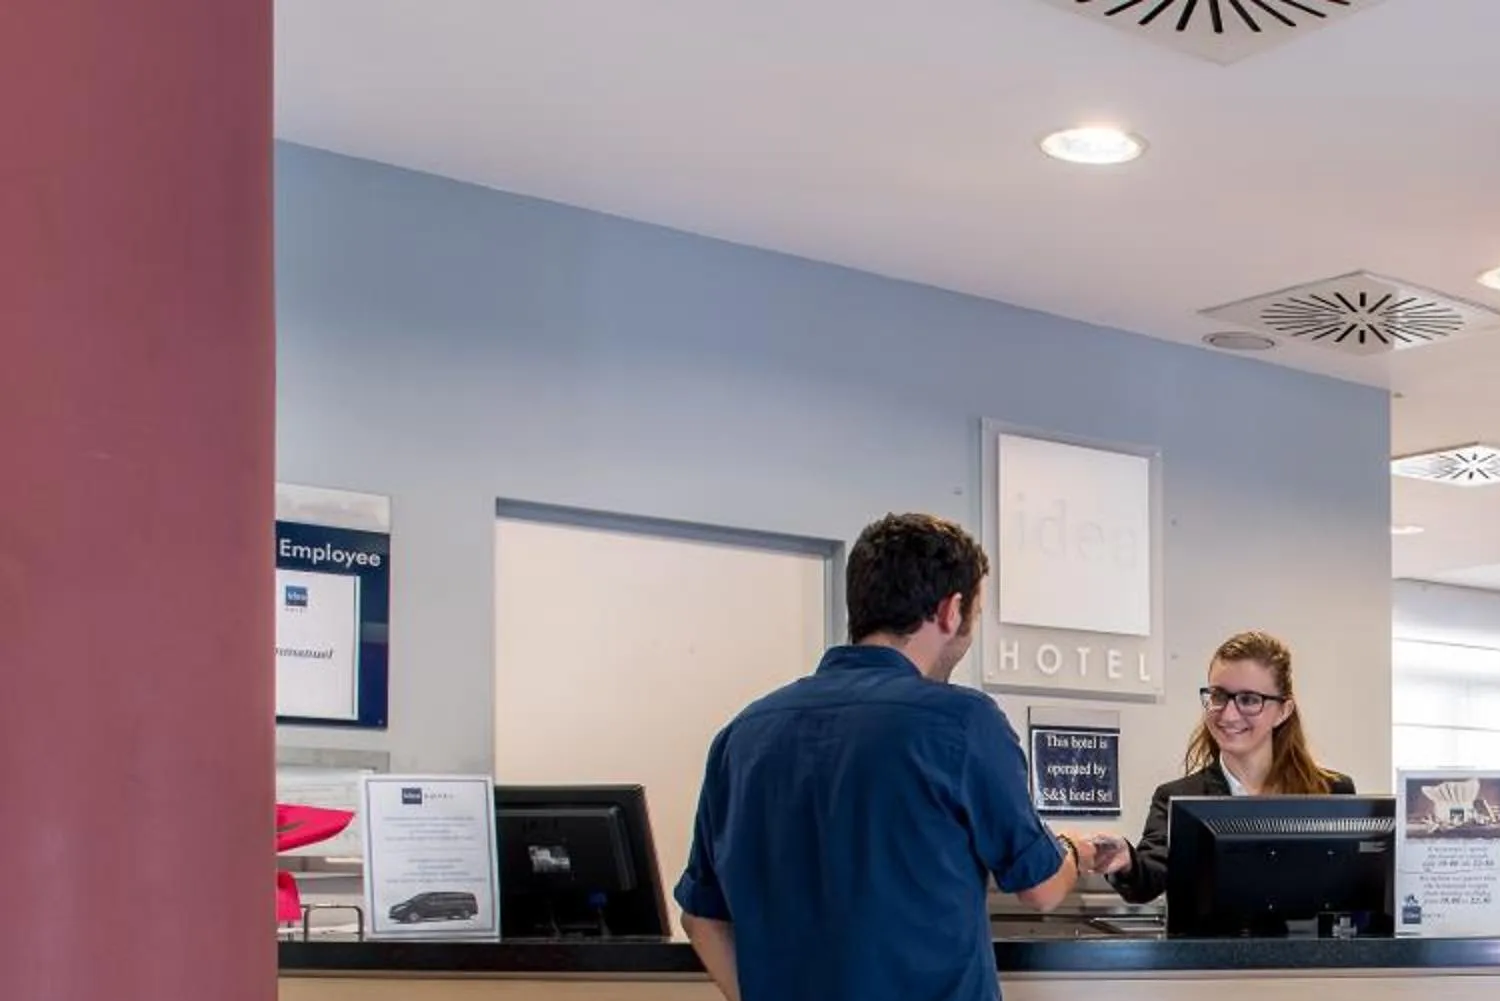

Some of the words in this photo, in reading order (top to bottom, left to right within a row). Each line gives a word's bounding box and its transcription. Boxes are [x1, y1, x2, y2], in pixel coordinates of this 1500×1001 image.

[1015, 491, 1138, 570] idea
[279, 538, 382, 568] Employee
[999, 639, 1151, 682] HOTEL
[1046, 735, 1069, 748] This
[1071, 736, 1097, 750] hotel
[1099, 738, 1109, 750] is
[1047, 763, 1091, 777] operated
[1093, 763, 1107, 779] by
[1043, 787, 1067, 801] S&S
[1069, 787, 1095, 802] hotel
